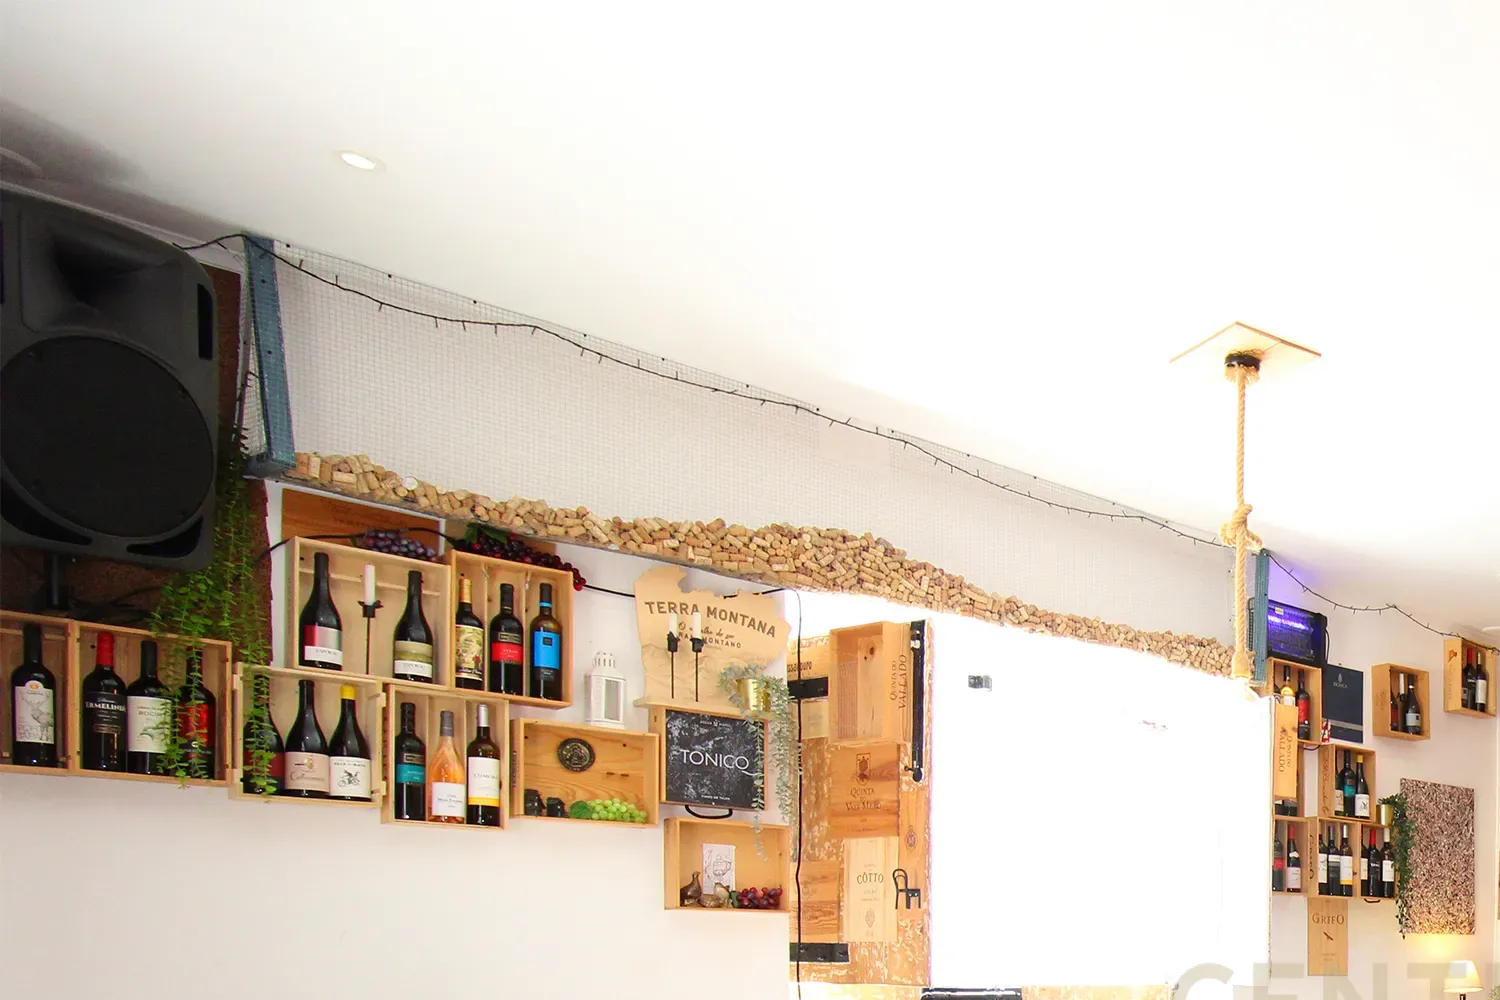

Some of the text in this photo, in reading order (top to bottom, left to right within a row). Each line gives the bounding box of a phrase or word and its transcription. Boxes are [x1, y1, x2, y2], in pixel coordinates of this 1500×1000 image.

[644, 601, 776, 639] TERRA MONTANA
[898, 654, 908, 709] VALLADO
[850, 787, 876, 798] QUINTA
[856, 871, 884, 885] CÔTTO
[1311, 912, 1345, 926] GRIFO
